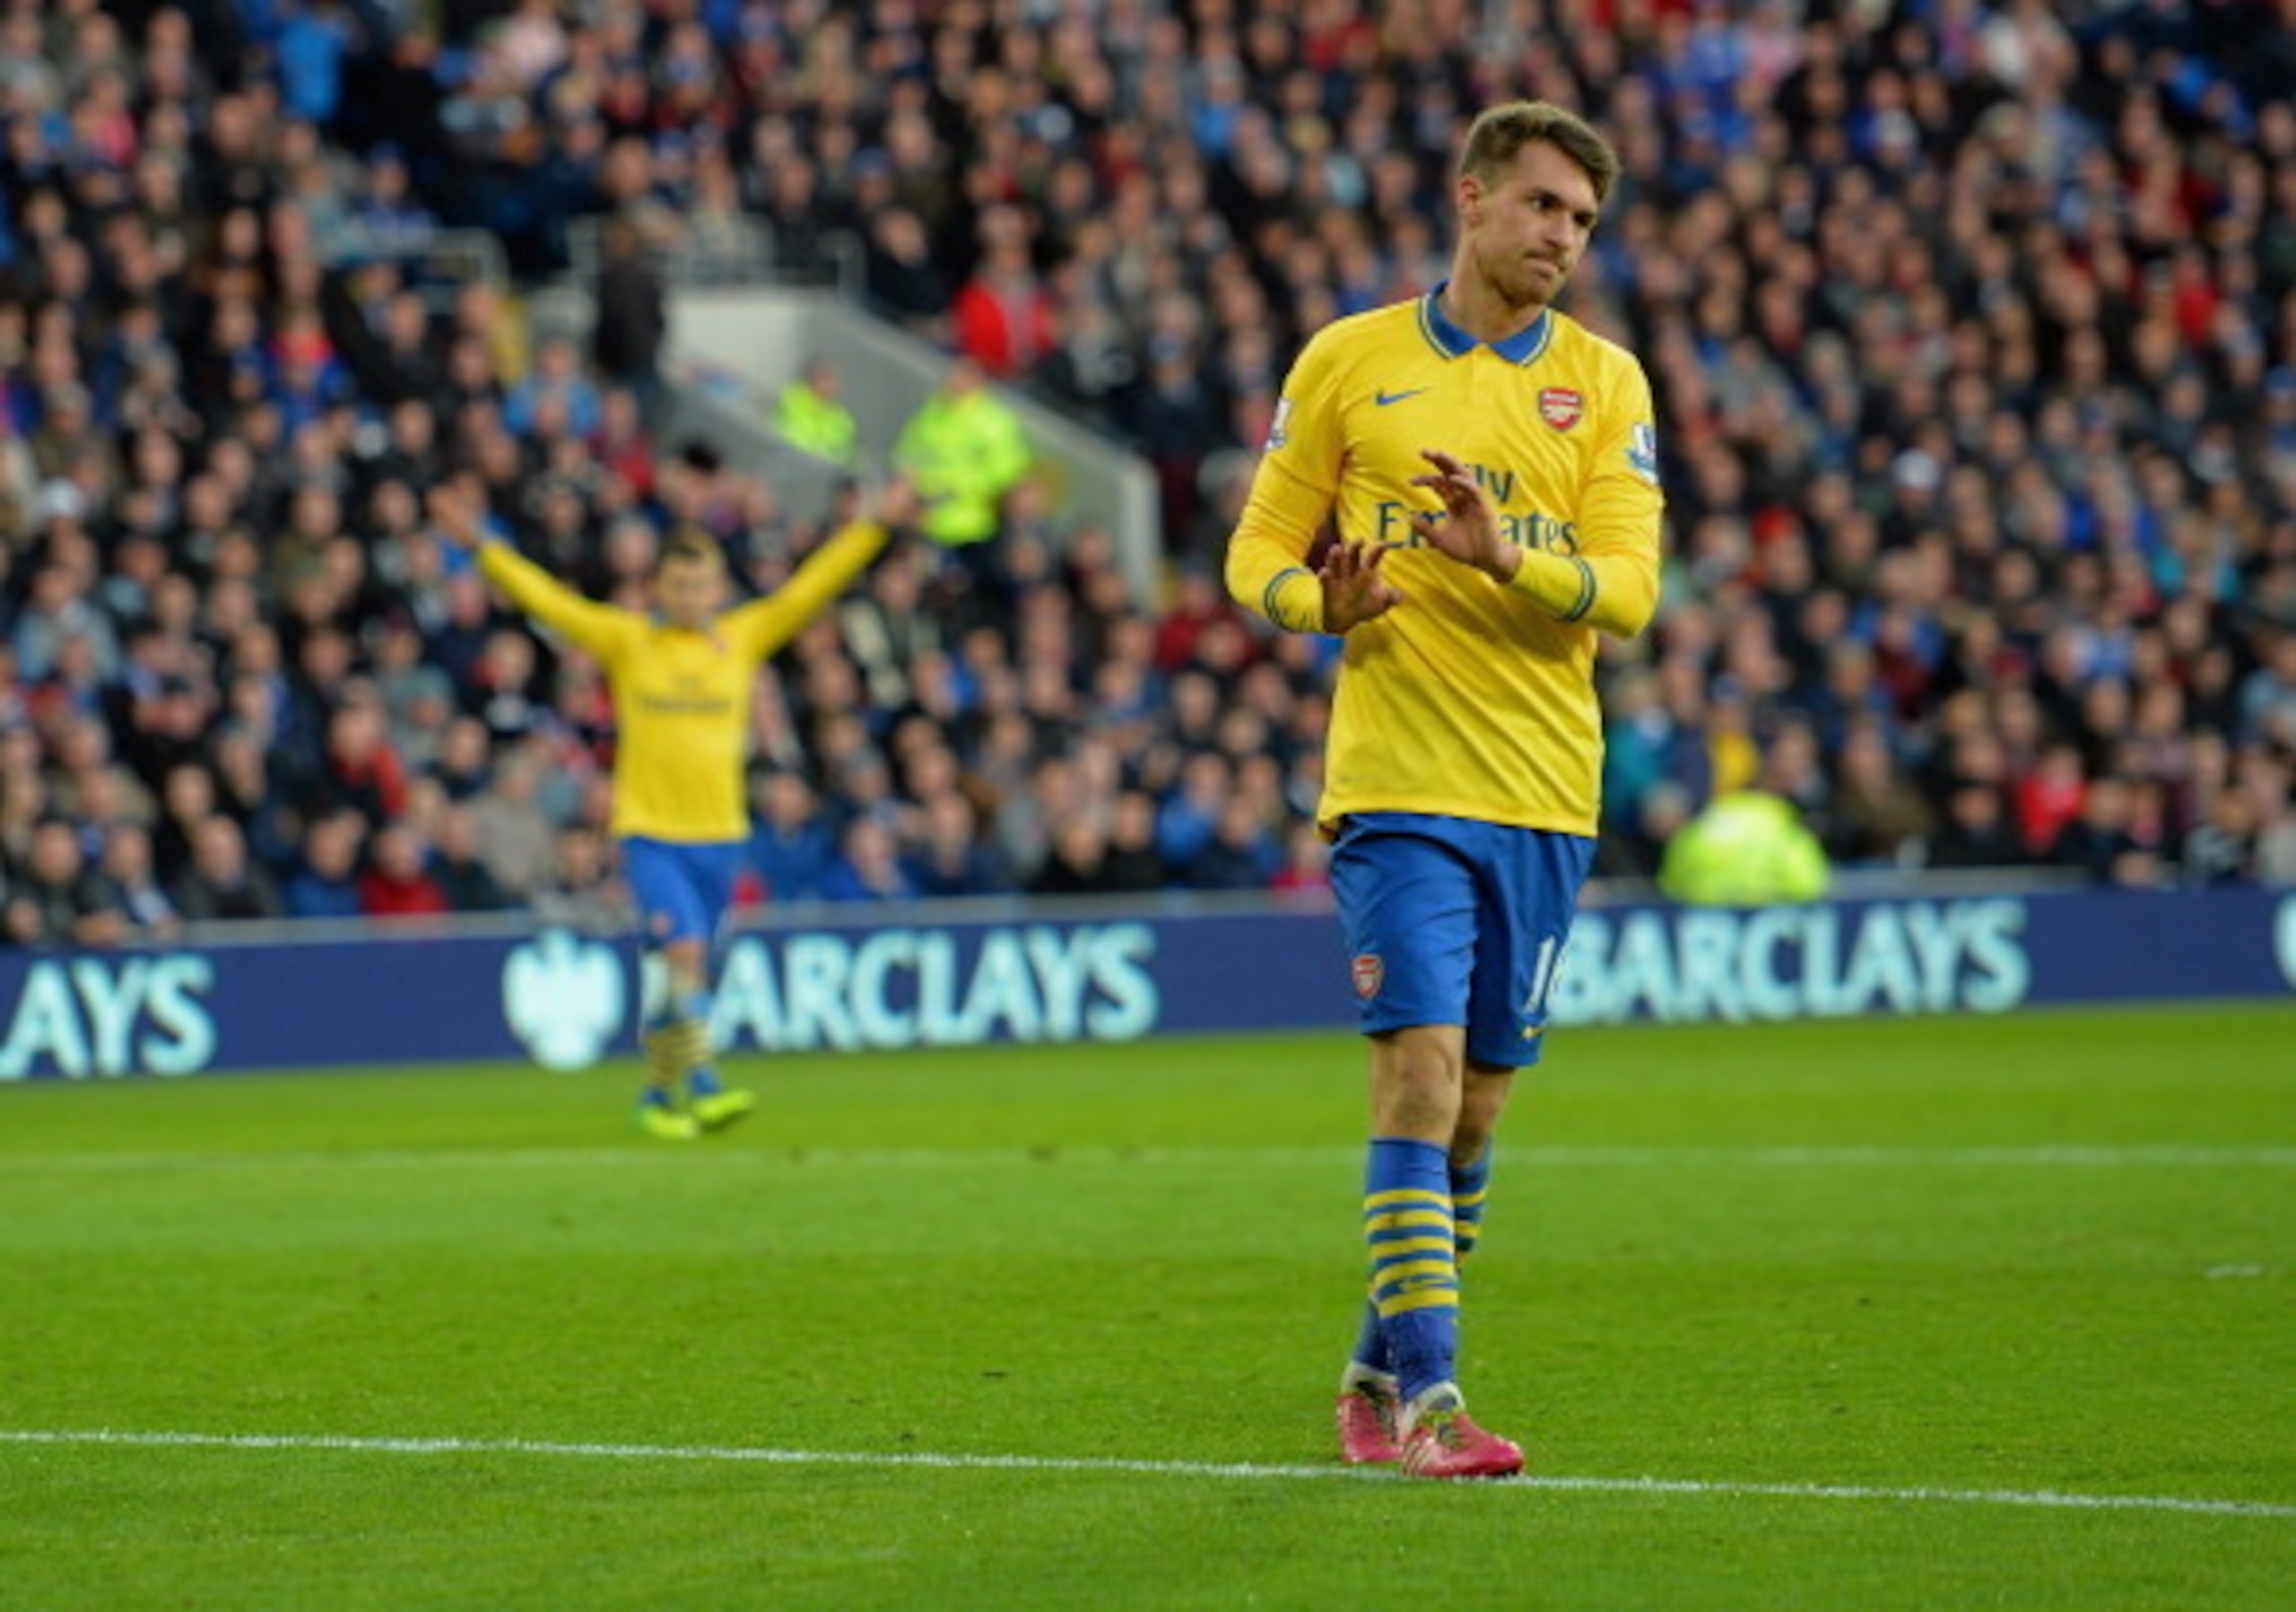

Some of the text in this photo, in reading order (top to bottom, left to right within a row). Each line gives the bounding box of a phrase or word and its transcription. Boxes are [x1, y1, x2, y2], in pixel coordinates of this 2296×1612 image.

[1465, 464, 1514, 503] ly
[1376, 501, 1578, 556] Eates
[1545, 896, 2029, 1024] BARCLAYS
